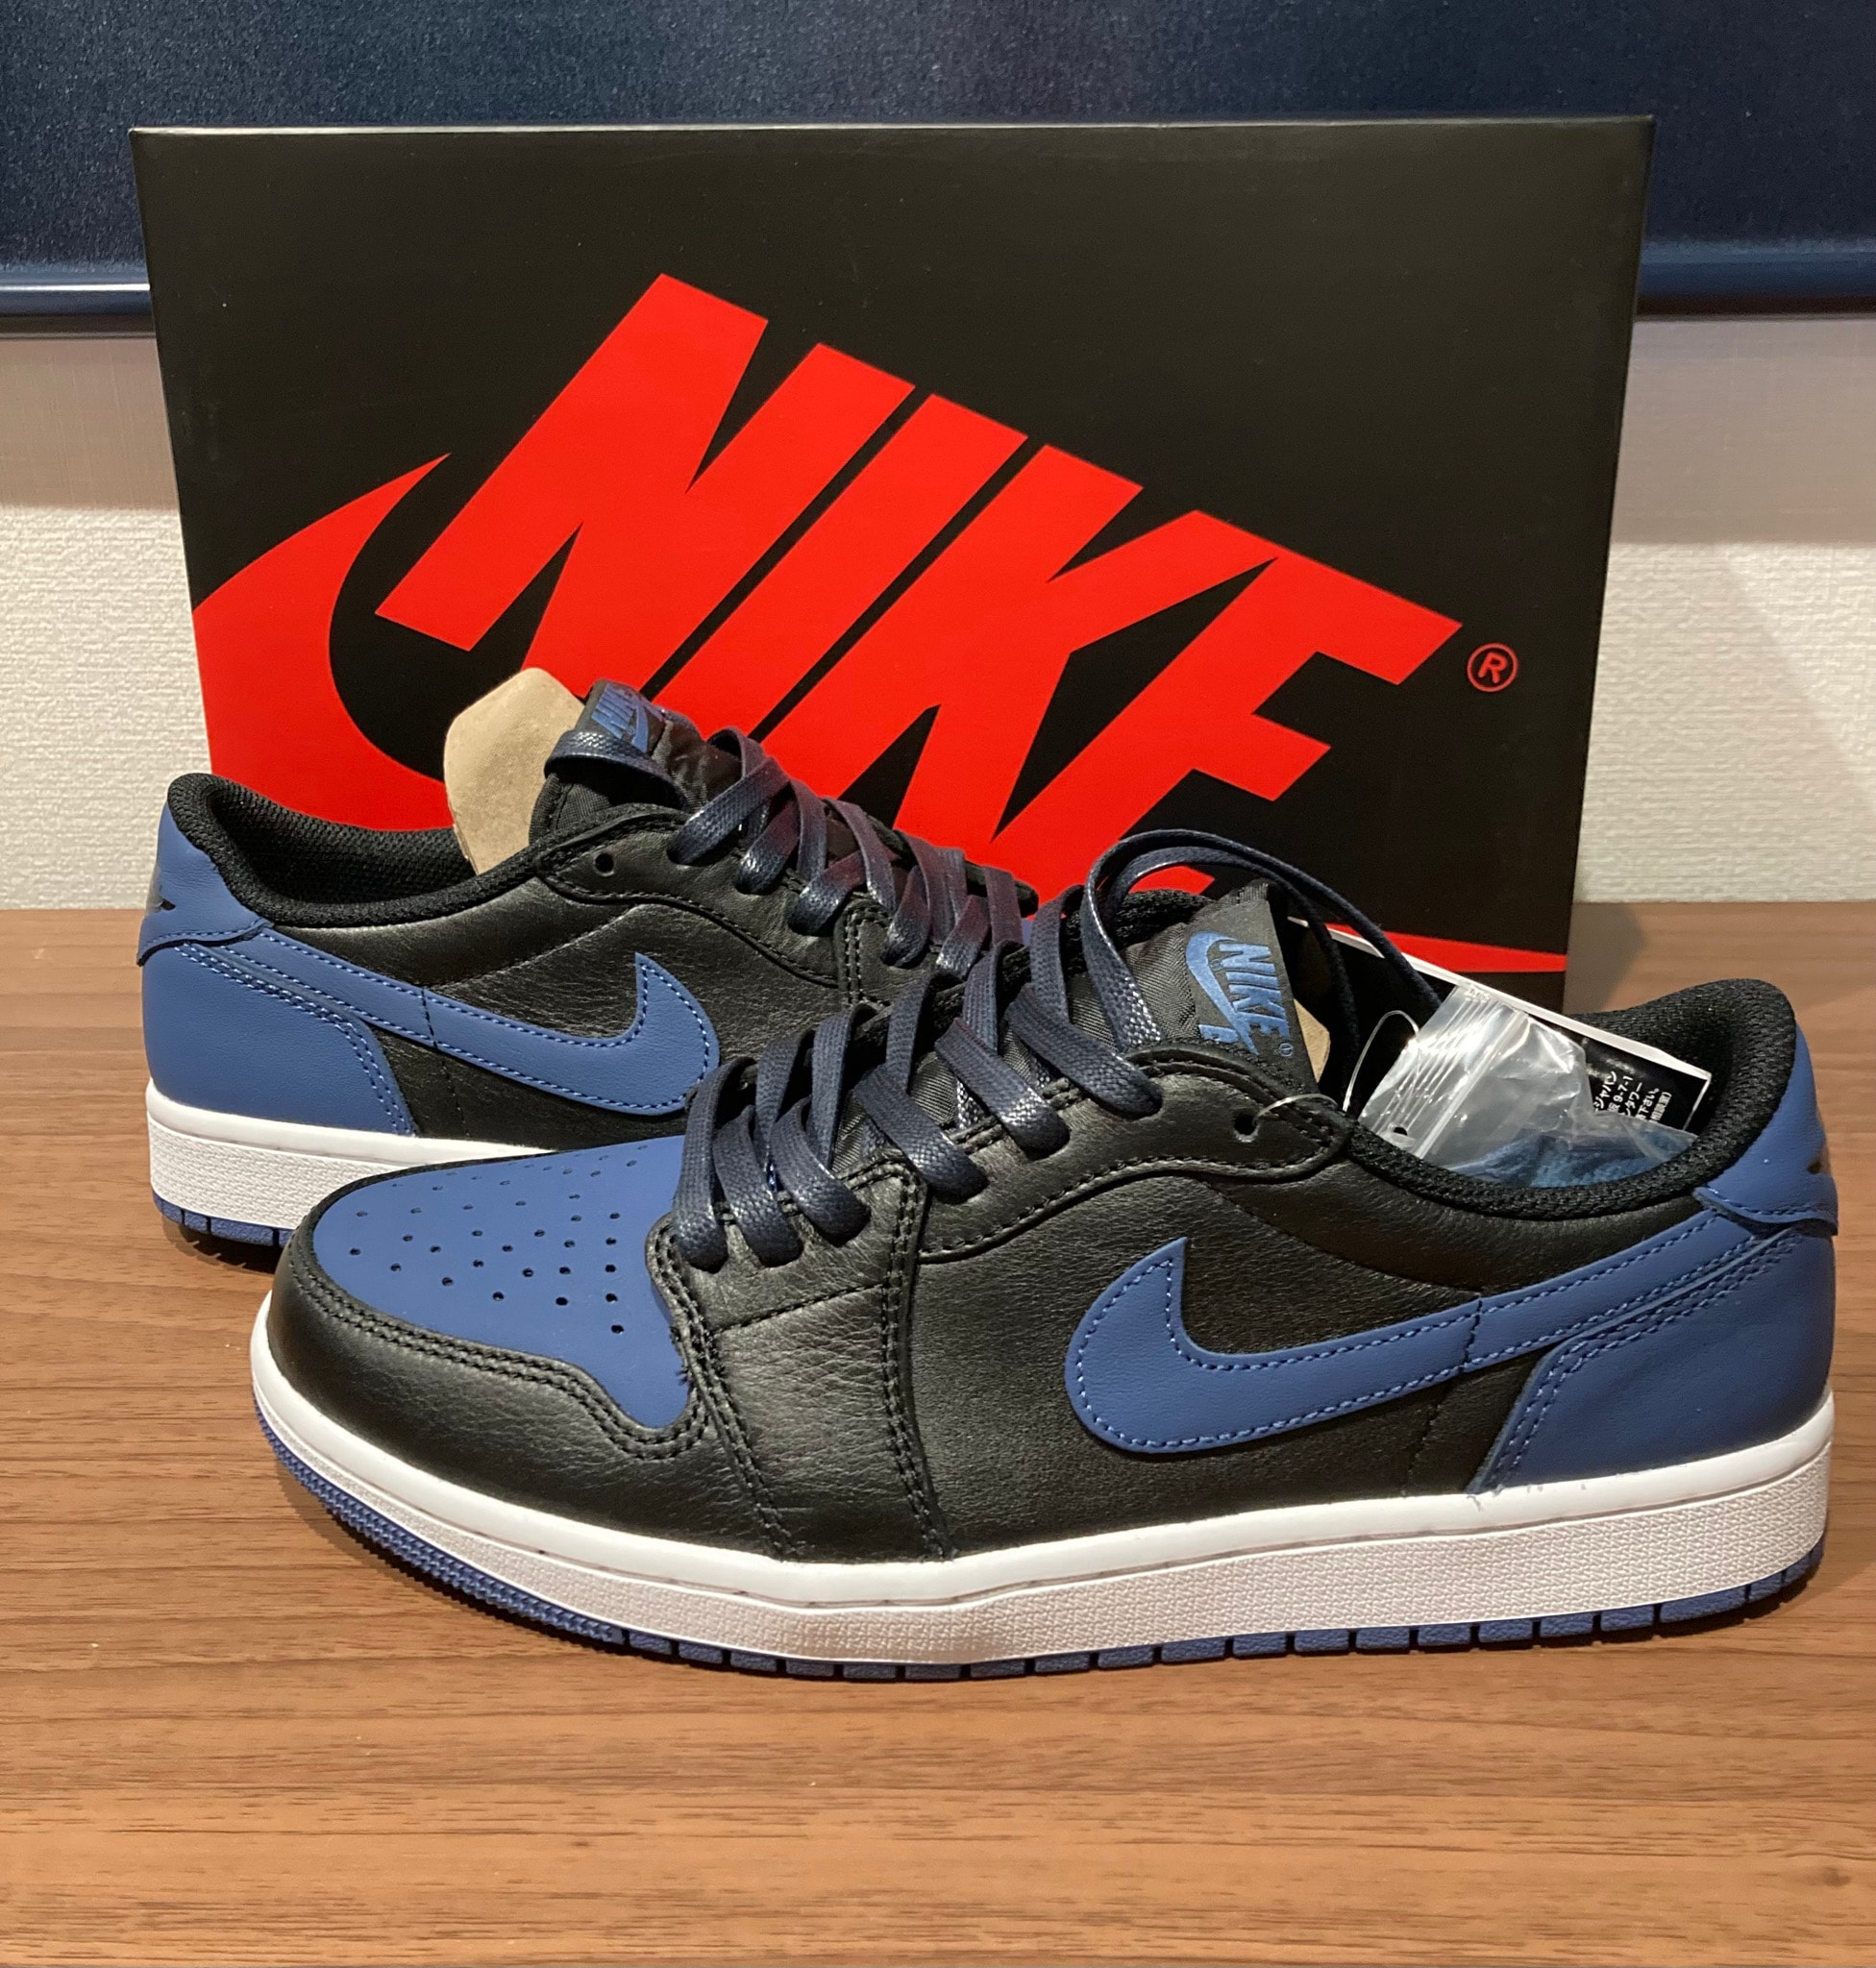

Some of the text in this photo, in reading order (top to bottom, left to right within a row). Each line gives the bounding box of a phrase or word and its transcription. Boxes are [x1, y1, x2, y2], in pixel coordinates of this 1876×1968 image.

[376, 274, 1463, 905] NIKE
[1218, 943, 1291, 1039] NIKE
[1593, 1070, 1617, 1112] ジャパン
